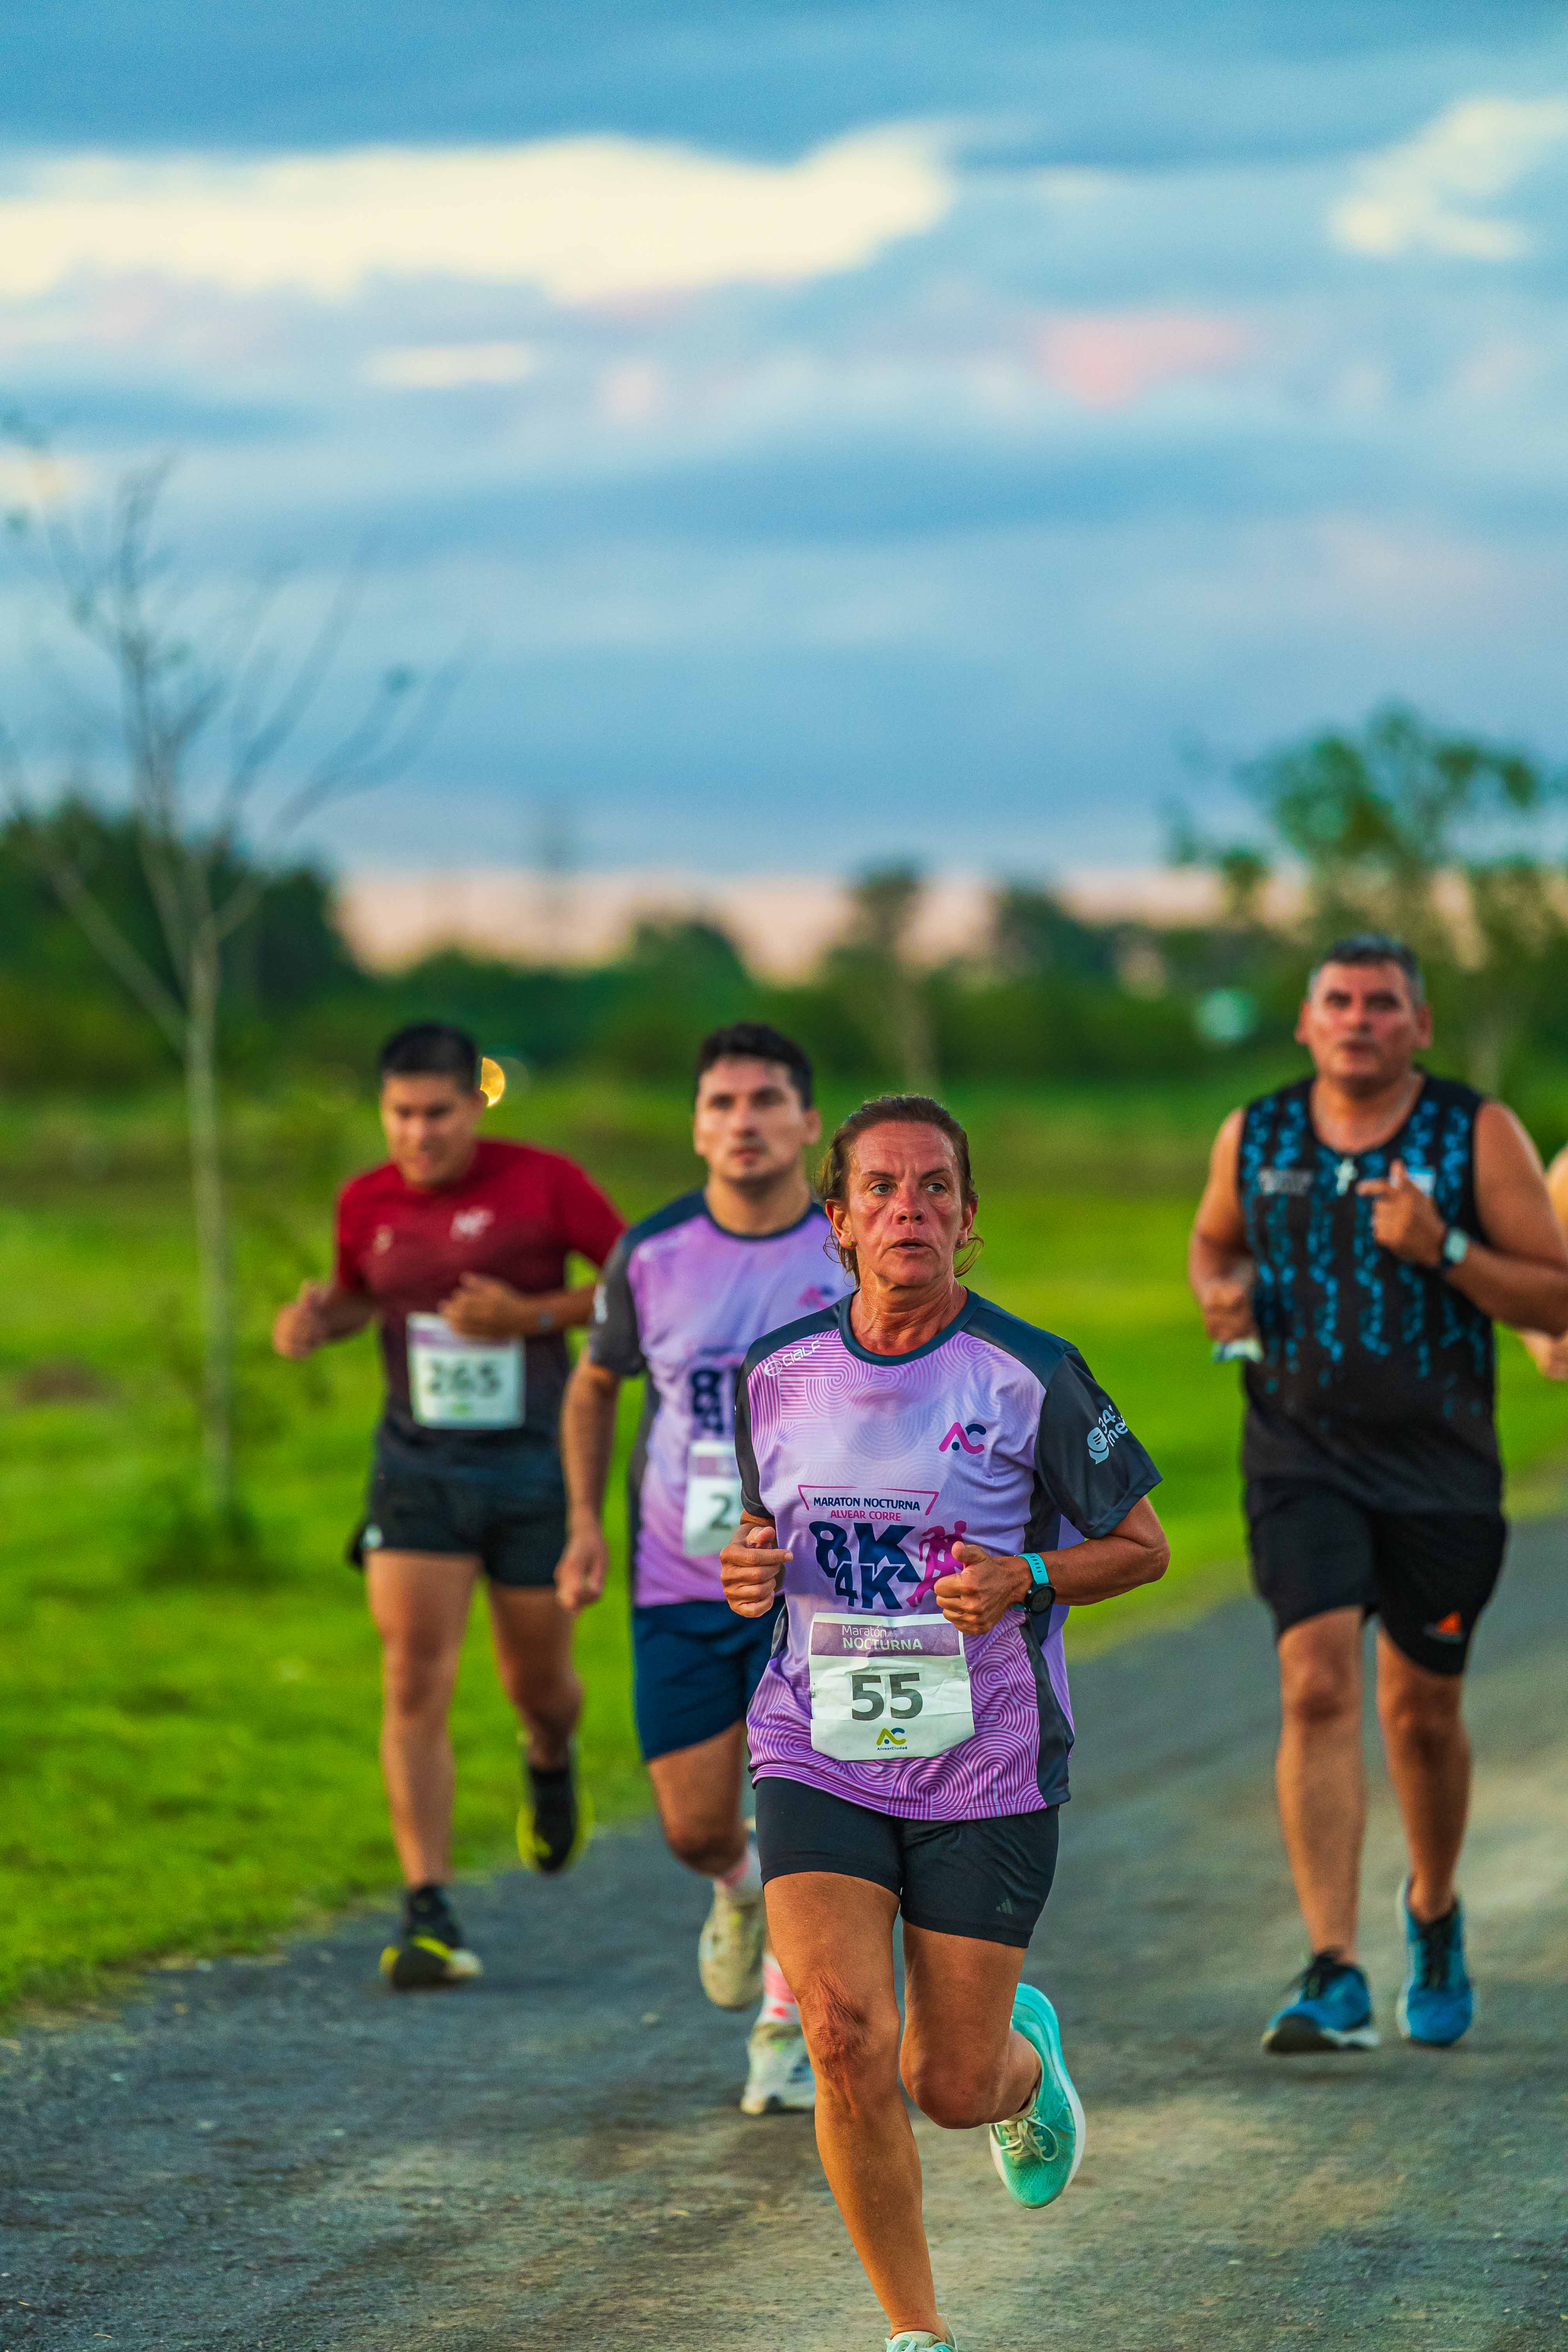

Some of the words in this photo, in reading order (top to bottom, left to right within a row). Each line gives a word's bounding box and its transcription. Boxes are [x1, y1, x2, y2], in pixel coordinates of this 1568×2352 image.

[692, 1365, 735, 1416] 8
[1107, 1414, 1128, 1447] me
[708, 1492, 734, 1529] 2
[813, 1497, 862, 1507] MARATON
[863, 1498, 920, 1511] NOCTURNA
[830, 1510, 866, 1520] ALVEAR
[869, 1511, 901, 1521] CORRE
[809, 1521, 922, 1583] 8K
[835, 1563, 903, 1610] 4K
[842, 1625, 887, 1638] Maratón
[842, 1637, 923, 1650] NOCTURNA
[852, 1672, 923, 1721] 55
